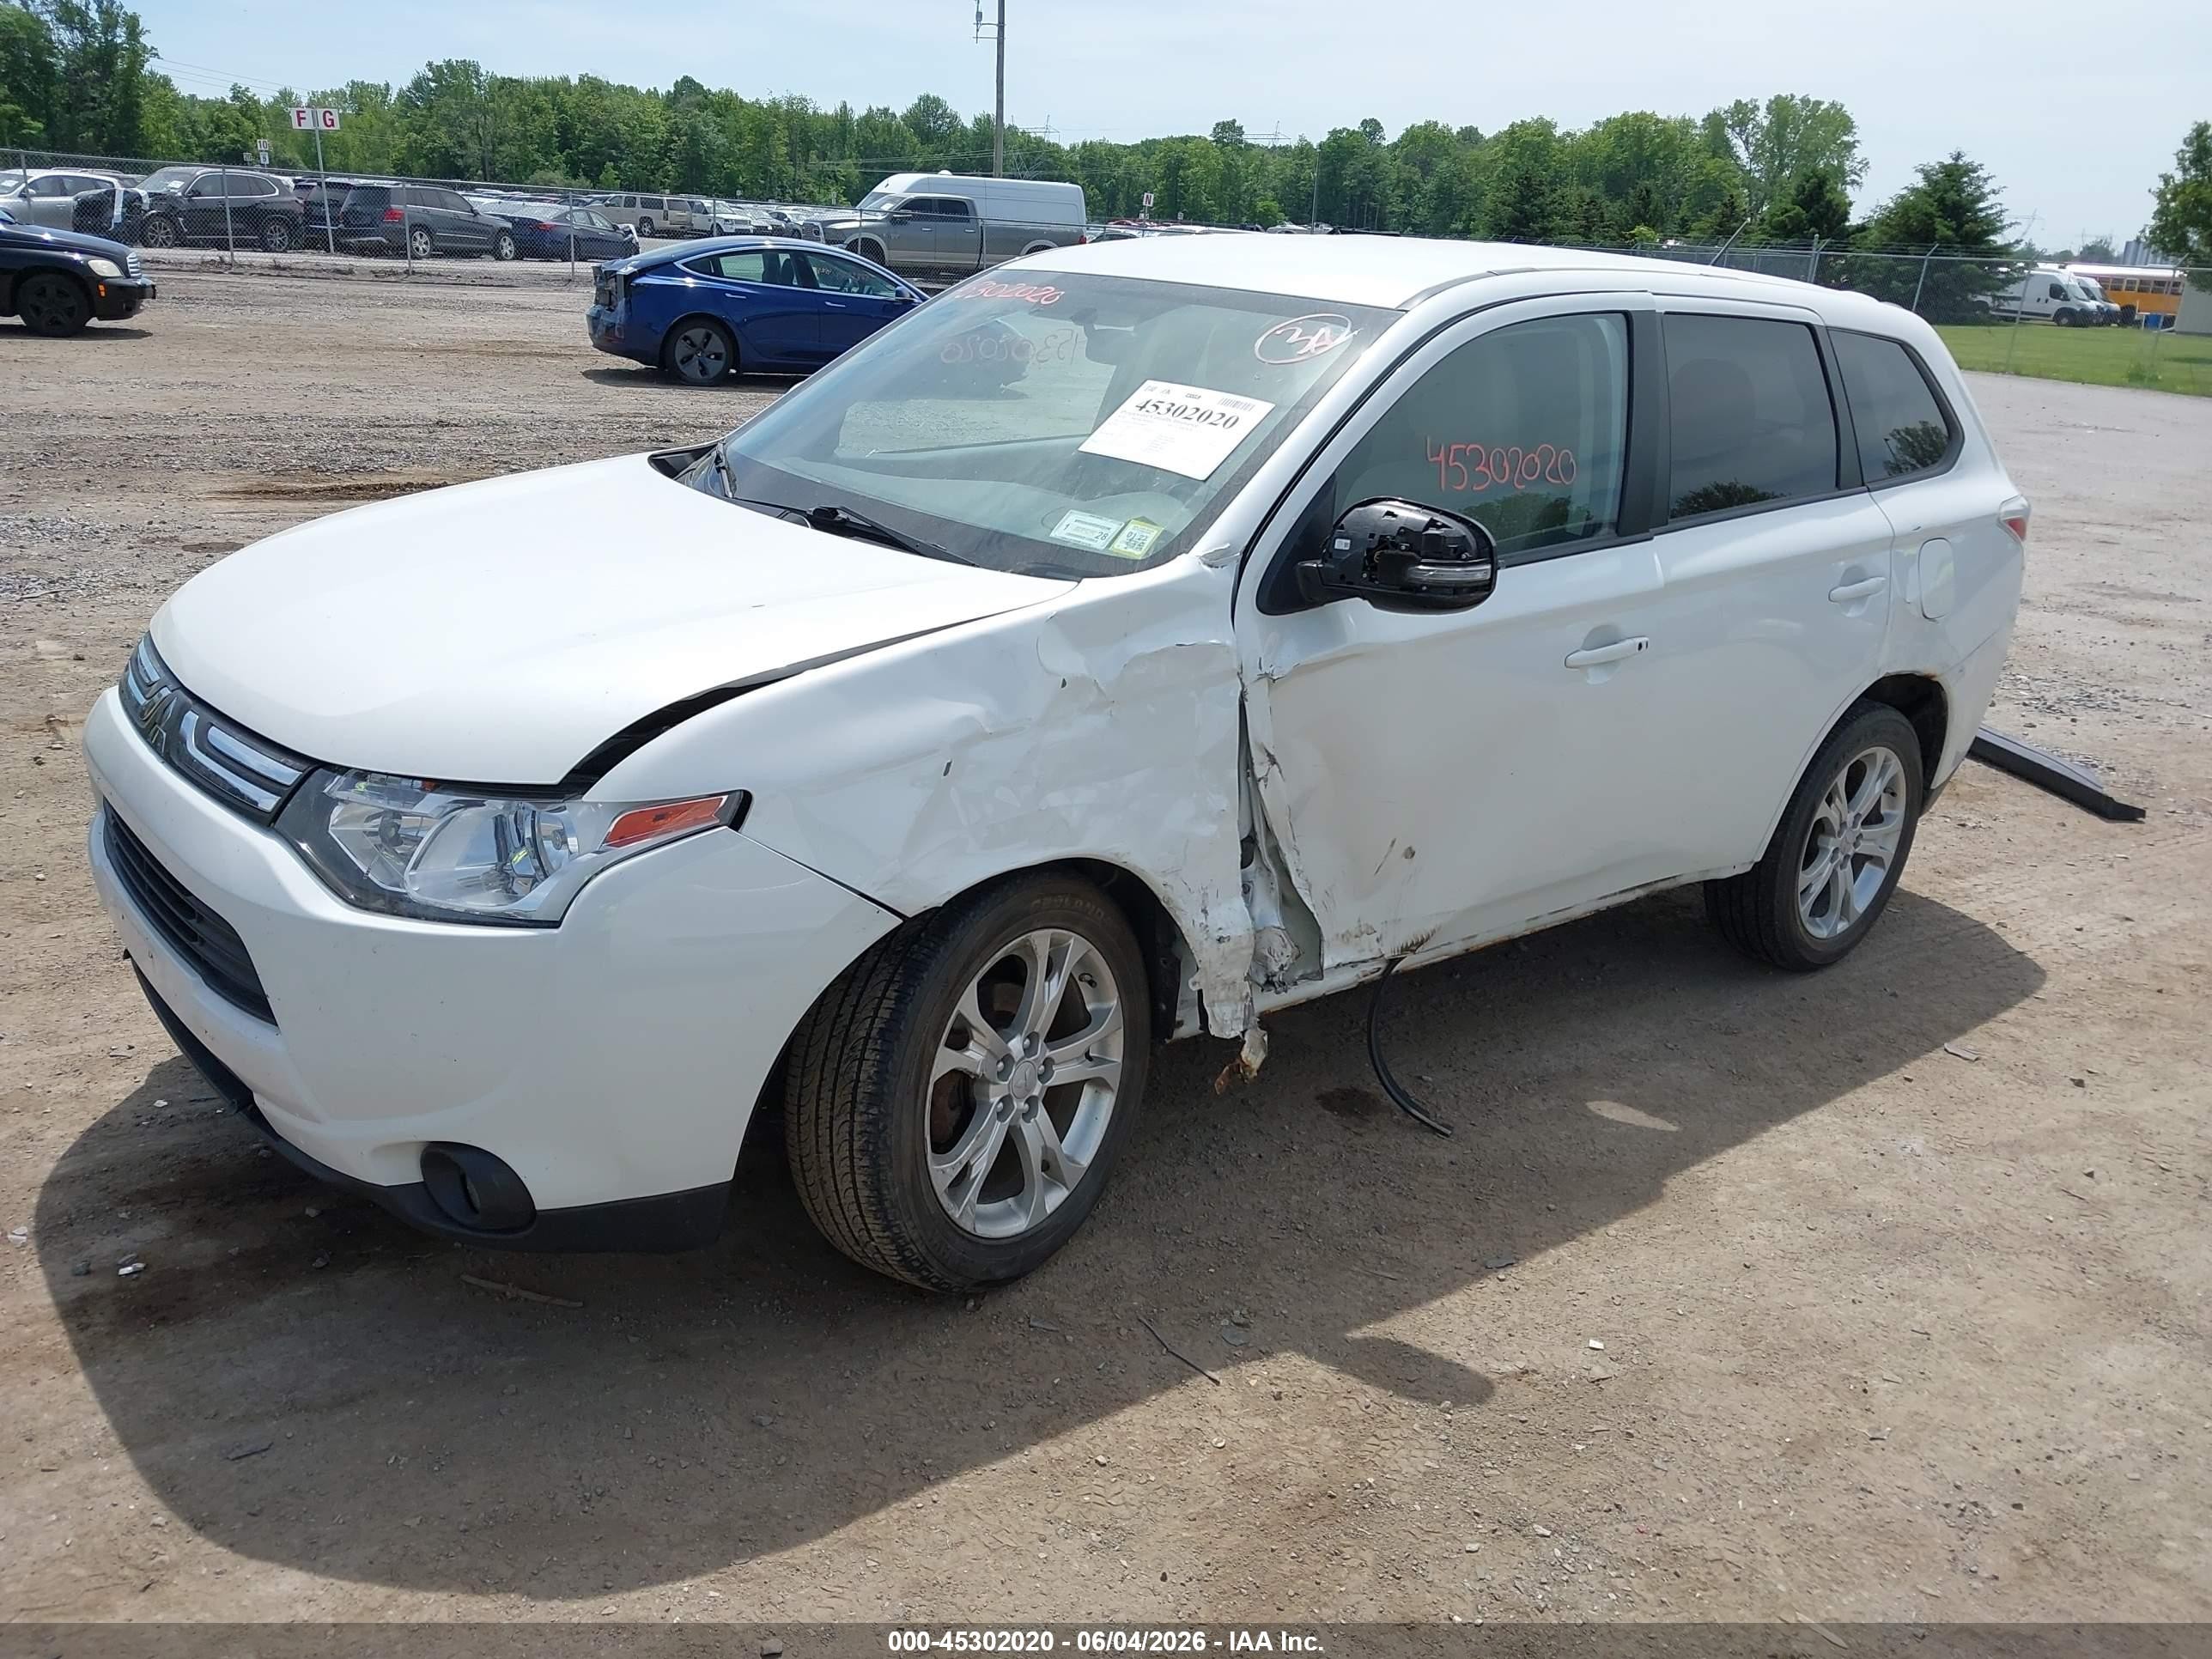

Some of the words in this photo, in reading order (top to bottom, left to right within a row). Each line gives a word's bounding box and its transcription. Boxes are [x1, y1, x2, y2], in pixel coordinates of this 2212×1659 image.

[295, 110, 307, 127] F
[322, 110, 335, 128] G
[258, 140, 268, 149] 10
[1145, 194, 1152, 204] N
[1135, 398, 1240, 430] 45302020
[1425, 434, 1577, 491] 45302020
[1095, 532, 1109, 541] 28
